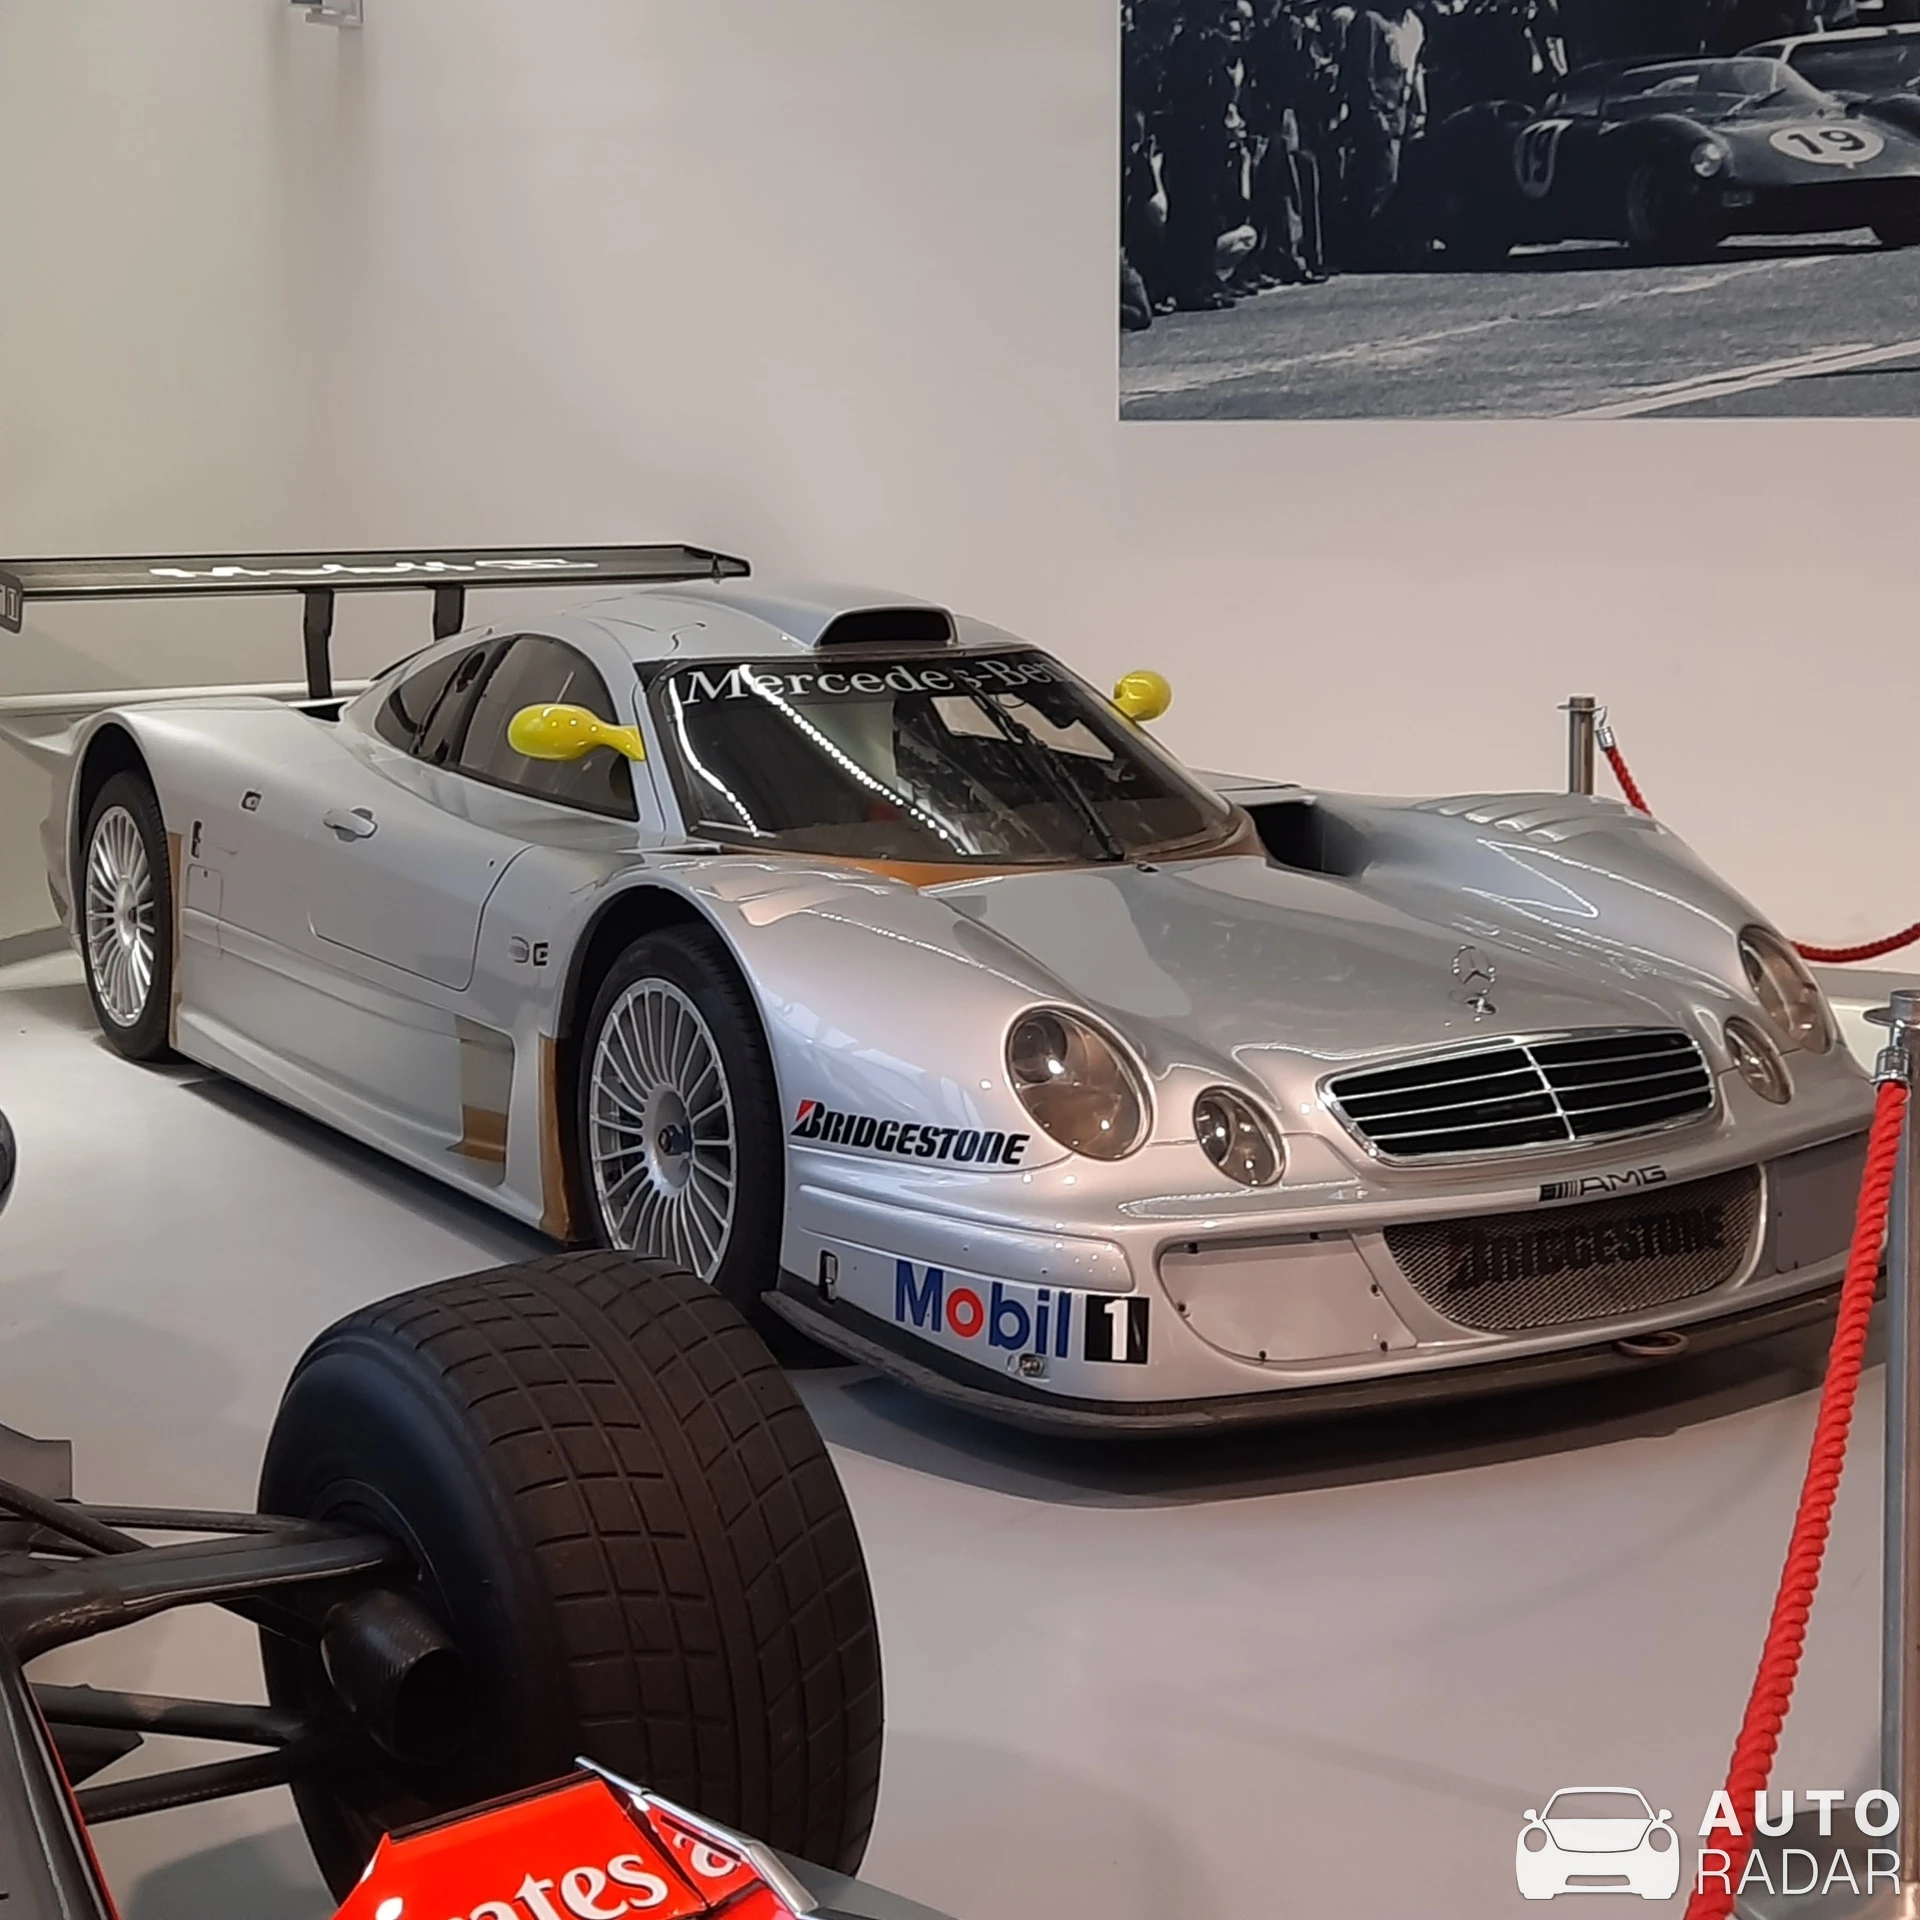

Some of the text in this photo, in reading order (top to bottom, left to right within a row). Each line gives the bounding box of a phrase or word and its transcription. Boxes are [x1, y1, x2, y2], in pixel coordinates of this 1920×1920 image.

[1787, 130, 1866, 155] 19
[683, 659, 1067, 705] Mercedes-Ben
[790, 1099, 1031, 1165] BRIDGESTONE
[1580, 1165, 1668, 1197] AMG
[895, 1259, 1130, 1362] Mobil 1
